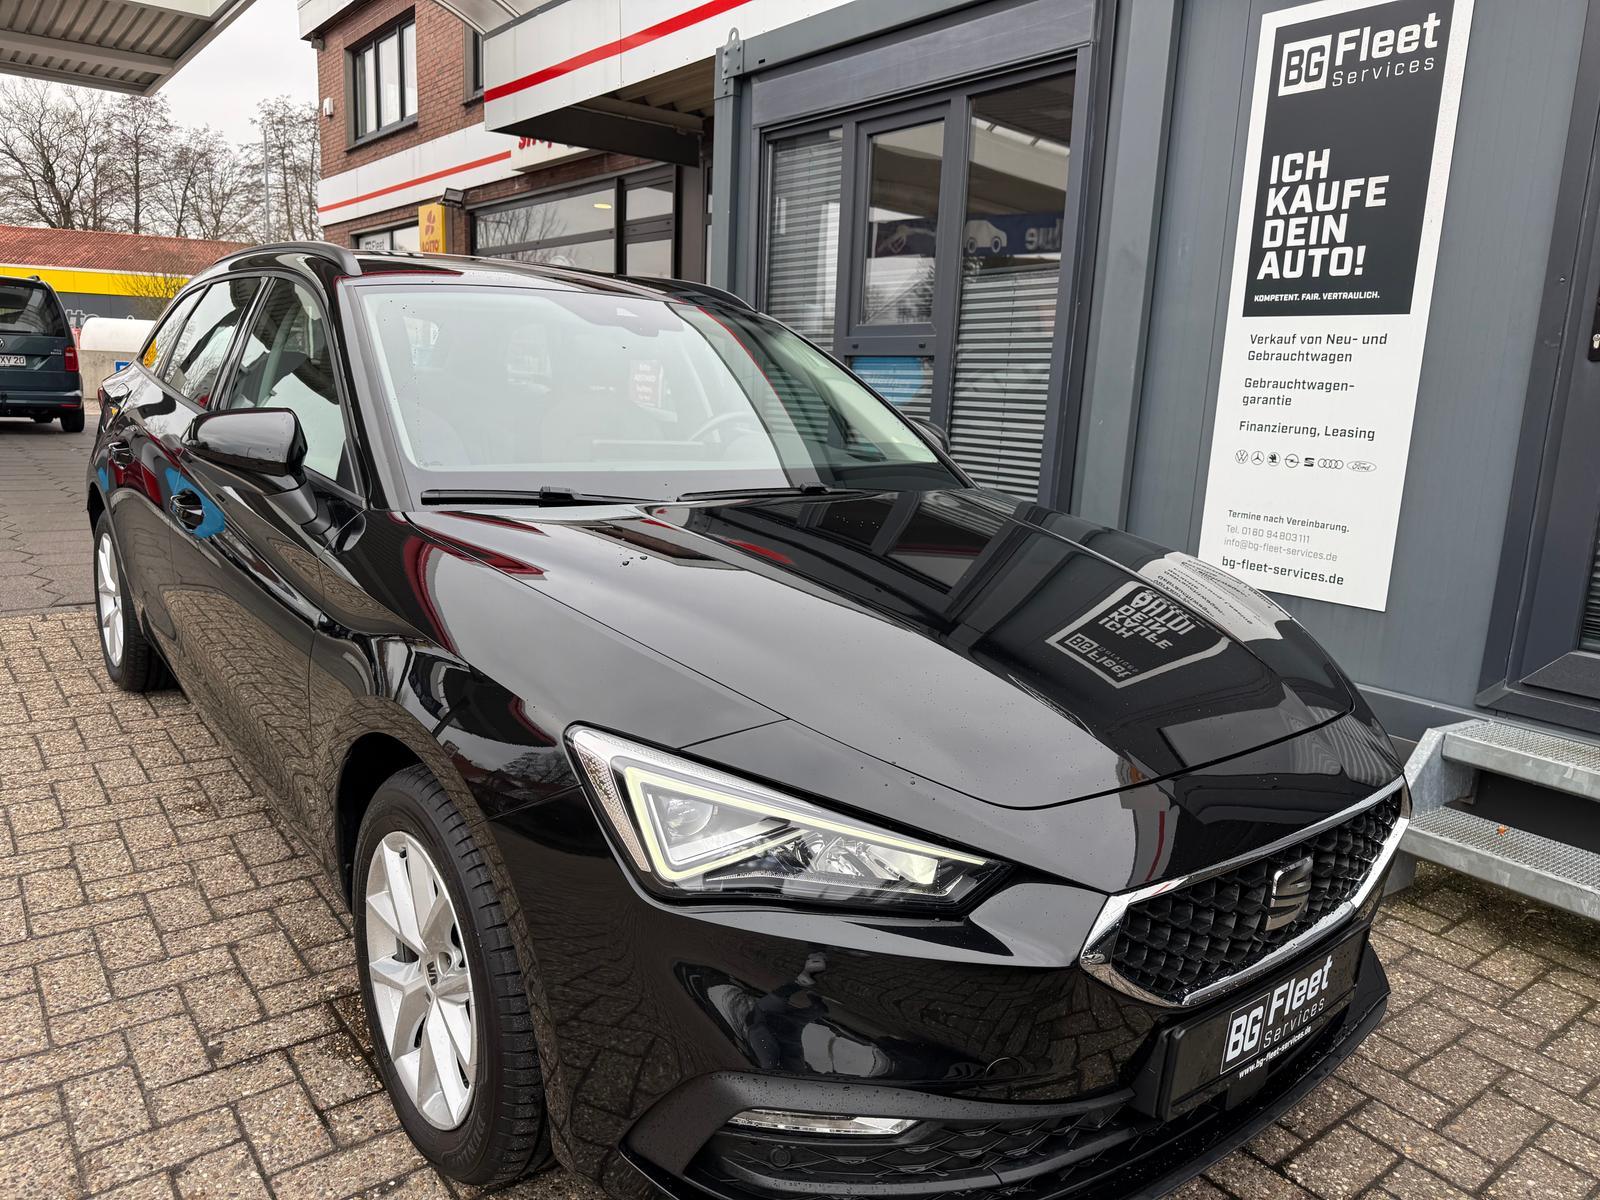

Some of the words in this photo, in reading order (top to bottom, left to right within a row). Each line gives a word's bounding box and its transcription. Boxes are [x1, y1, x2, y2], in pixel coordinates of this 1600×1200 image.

[1281, 42, 1327, 89] BG
[1334, 12, 1441, 67] Fleet
[1332, 57, 1435, 88] Services
[1269, 148, 1331, 184] ICH
[1265, 175, 1390, 217] KAUFE
[1262, 213, 1348, 249] DEIN
[1256, 245, 1366, 280] AUTO!
[1253, 293, 1300, 302] KOMPETENT.
[1301, 292, 1321, 301] FAIR.
[1322, 290, 1381, 300] VERTRAULICH.
[1250, 333, 1297, 345] Verkauf
[1300, 335, 1322, 345] von
[1326, 333, 1359, 345] Neu-
[1362, 333, 1388, 345] und
[1247, 350, 1353, 364] Gebrauchtwagen
[1244, 377, 1355, 393] Gebrauchtwagen-
[1242, 394, 1292, 406] garantie
[1239, 420, 1321, 438] Finanzierung,
[1324, 425, 1376, 442] Leasing
[1226, 524, 1240, 535] Tel.
[1228, 509, 1261, 521] Termine
[1263, 515, 1284, 524] nach
[1286, 516, 1350, 534] Vereinbarung.
[1224, 537, 1338, 562] info@bg-fleet-services.de
[1221, 555, 1345, 586] bg-fleet-services.de
[1225, 1005, 1264, 1063] BG
[1267, 954, 1333, 1027] Fleet
[1263, 996, 1326, 1049] Services
